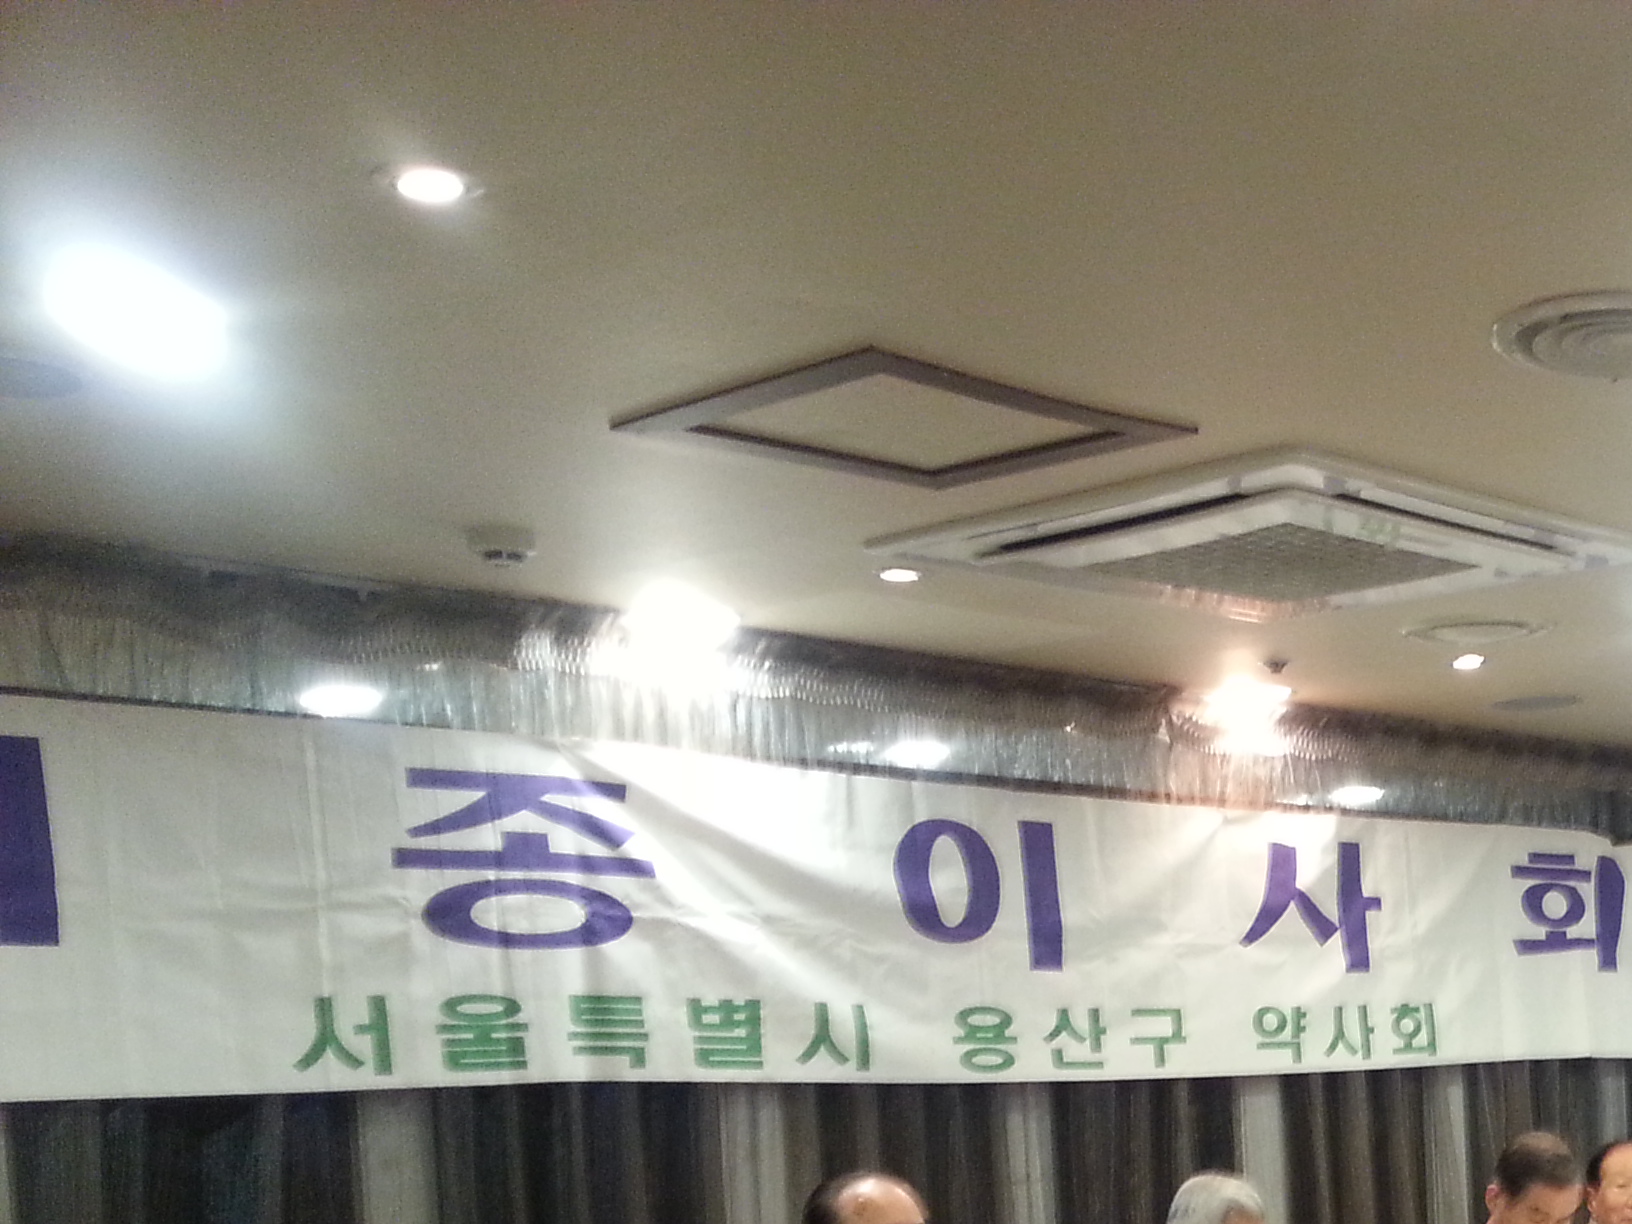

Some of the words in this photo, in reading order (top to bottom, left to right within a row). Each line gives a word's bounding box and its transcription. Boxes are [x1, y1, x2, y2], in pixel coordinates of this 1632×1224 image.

[0, 735, 1626, 972] 종이사회
[293, 992, 872, 1075] 서울특별시
[952, 1005, 1188, 1072] 용산구
[1253, 1002, 1439, 1063] 약사회
